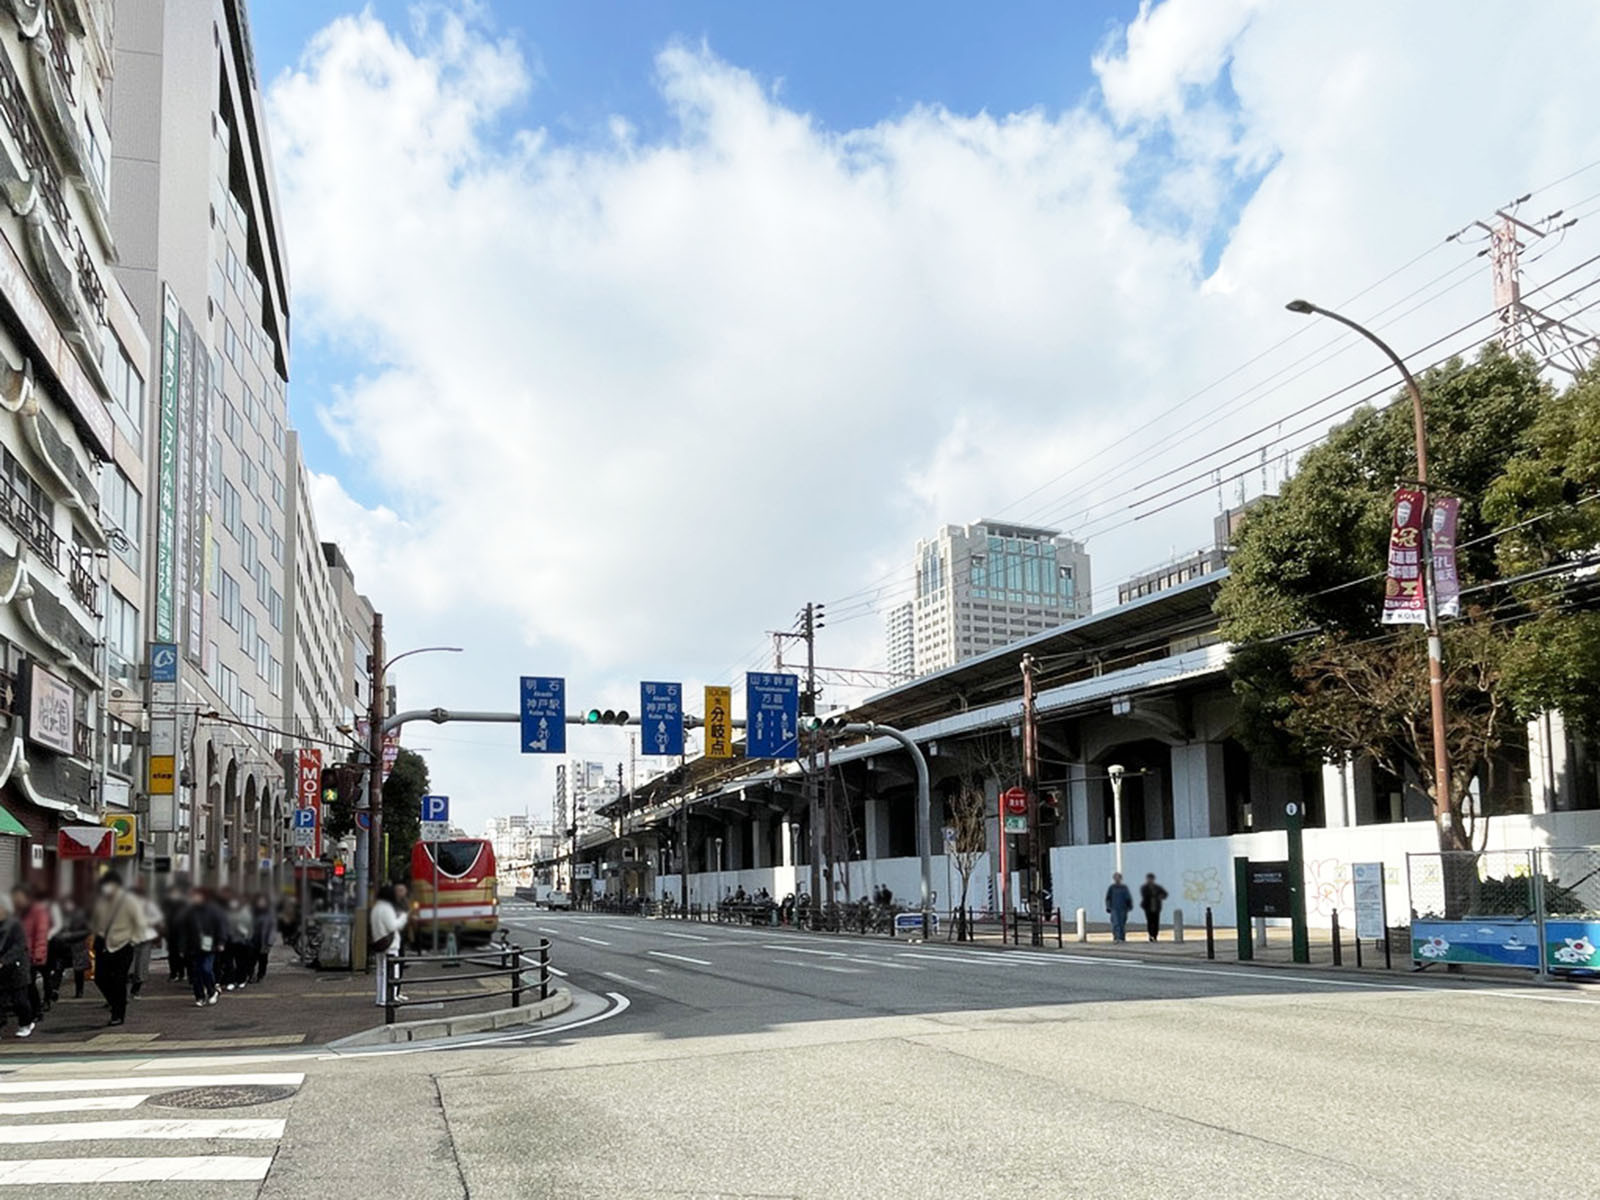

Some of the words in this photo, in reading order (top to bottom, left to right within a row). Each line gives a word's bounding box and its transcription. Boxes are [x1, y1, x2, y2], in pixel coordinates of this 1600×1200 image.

[526, 679, 560, 691] 明石
[645, 684, 677, 696] 明石
[526, 699, 561, 710] 神戸駅
[645, 703, 678, 714] 神戸駅
[711, 706, 726, 756] 分岐点
[429, 798, 445, 820] P
[300, 812, 312, 826] P
